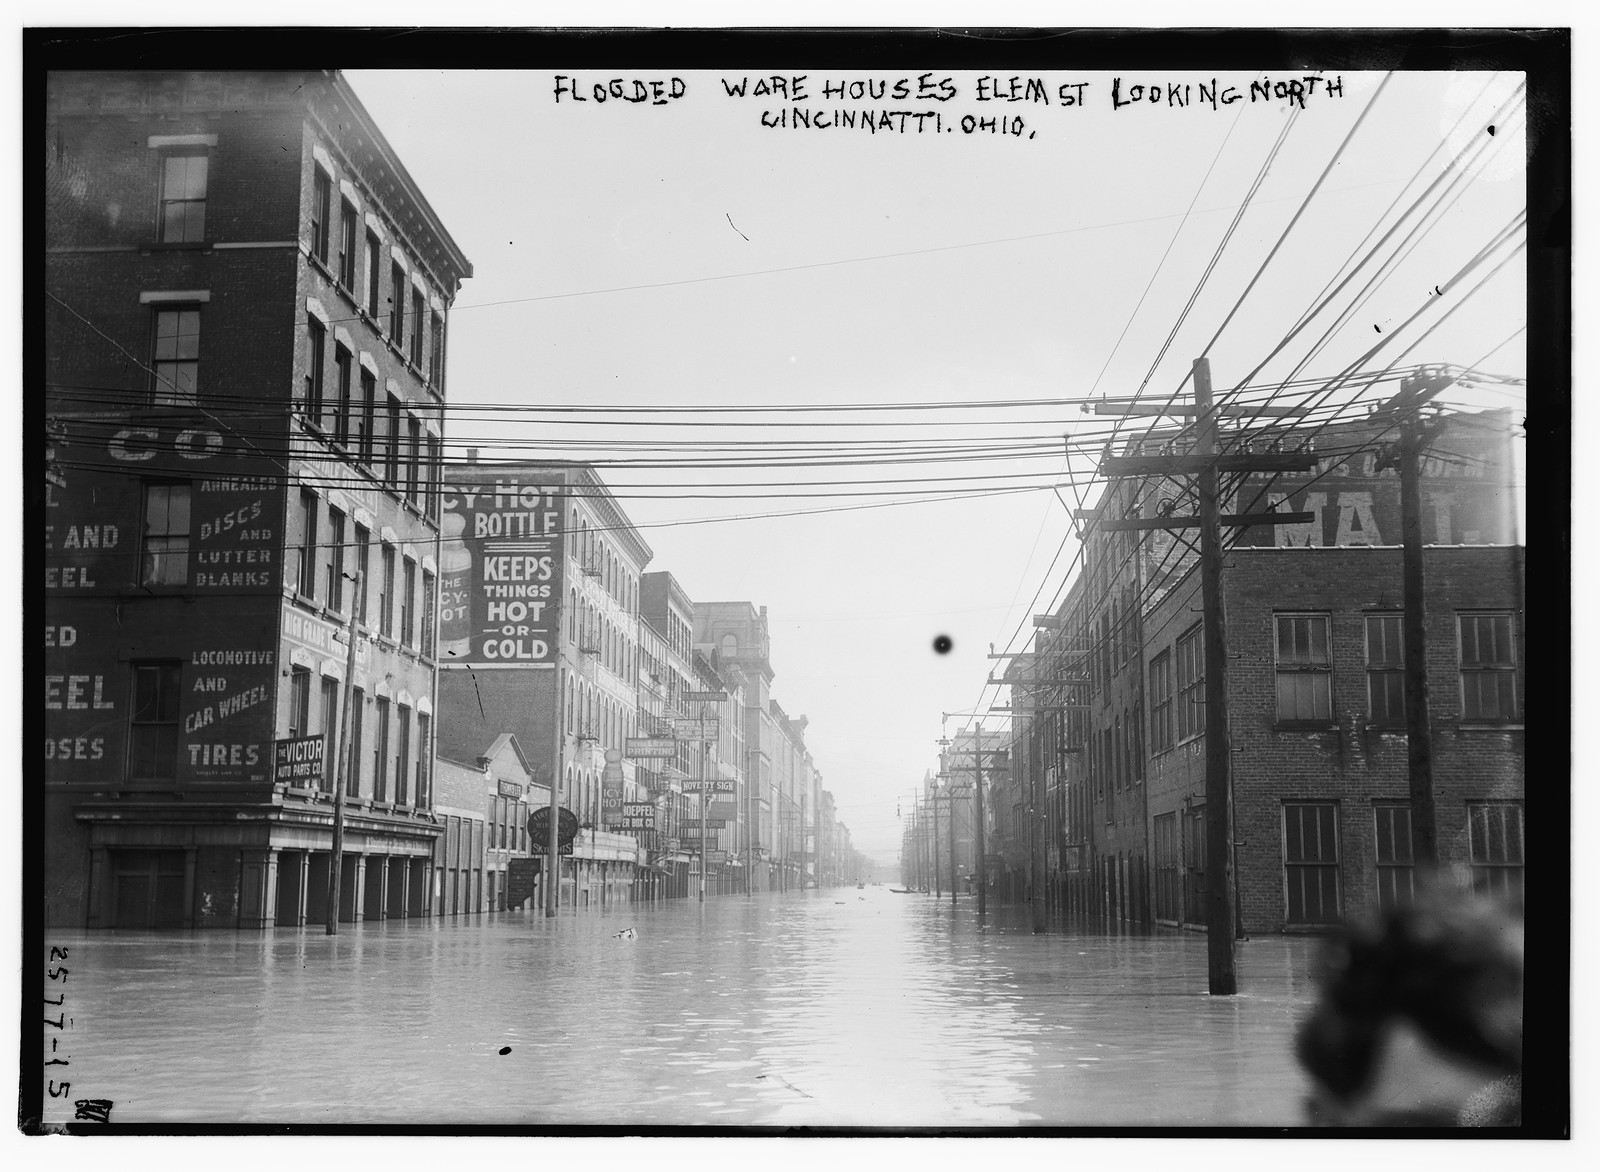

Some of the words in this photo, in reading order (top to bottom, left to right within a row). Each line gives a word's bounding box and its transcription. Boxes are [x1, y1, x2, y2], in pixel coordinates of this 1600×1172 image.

[201, 477, 277, 492] ANNEALED
[201, 500, 262, 541] DISCS
[475, 512, 559, 538] BOTTLE
[1267, 491, 1481, 546] MAT.
[63, 525, 119, 548] AND
[240, 529, 272, 541] AND
[484, 556, 552, 581] KEEPS
[196, 572, 270, 586] BLANKS
[483, 585, 552, 597] THINGS
[488, 602, 546, 622] HOT
[502, 625, 530, 636] OR
[483, 639, 549, 659] COLD
[192, 651, 273, 665] LOCOMOTIVE
[46, 674, 114, 709] EEL
[193, 677, 227, 692] AND
[185, 707, 214, 734] CAR
[219, 685, 269, 719] WHEEL
[188, 744, 259, 766] TIRES
[278, 748, 286, 758] THE
[286, 739, 323, 762] VICTOR
[627, 747, 675, 756] PRINTING
[278, 765, 291, 777] AUTO
[293, 763, 310, 776] PARTS
[683, 781, 715, 791] NOVETY
[716, 781, 734, 791] SIGN
[603, 798, 623, 807] HOT
[631, 818, 644, 828] BOX
